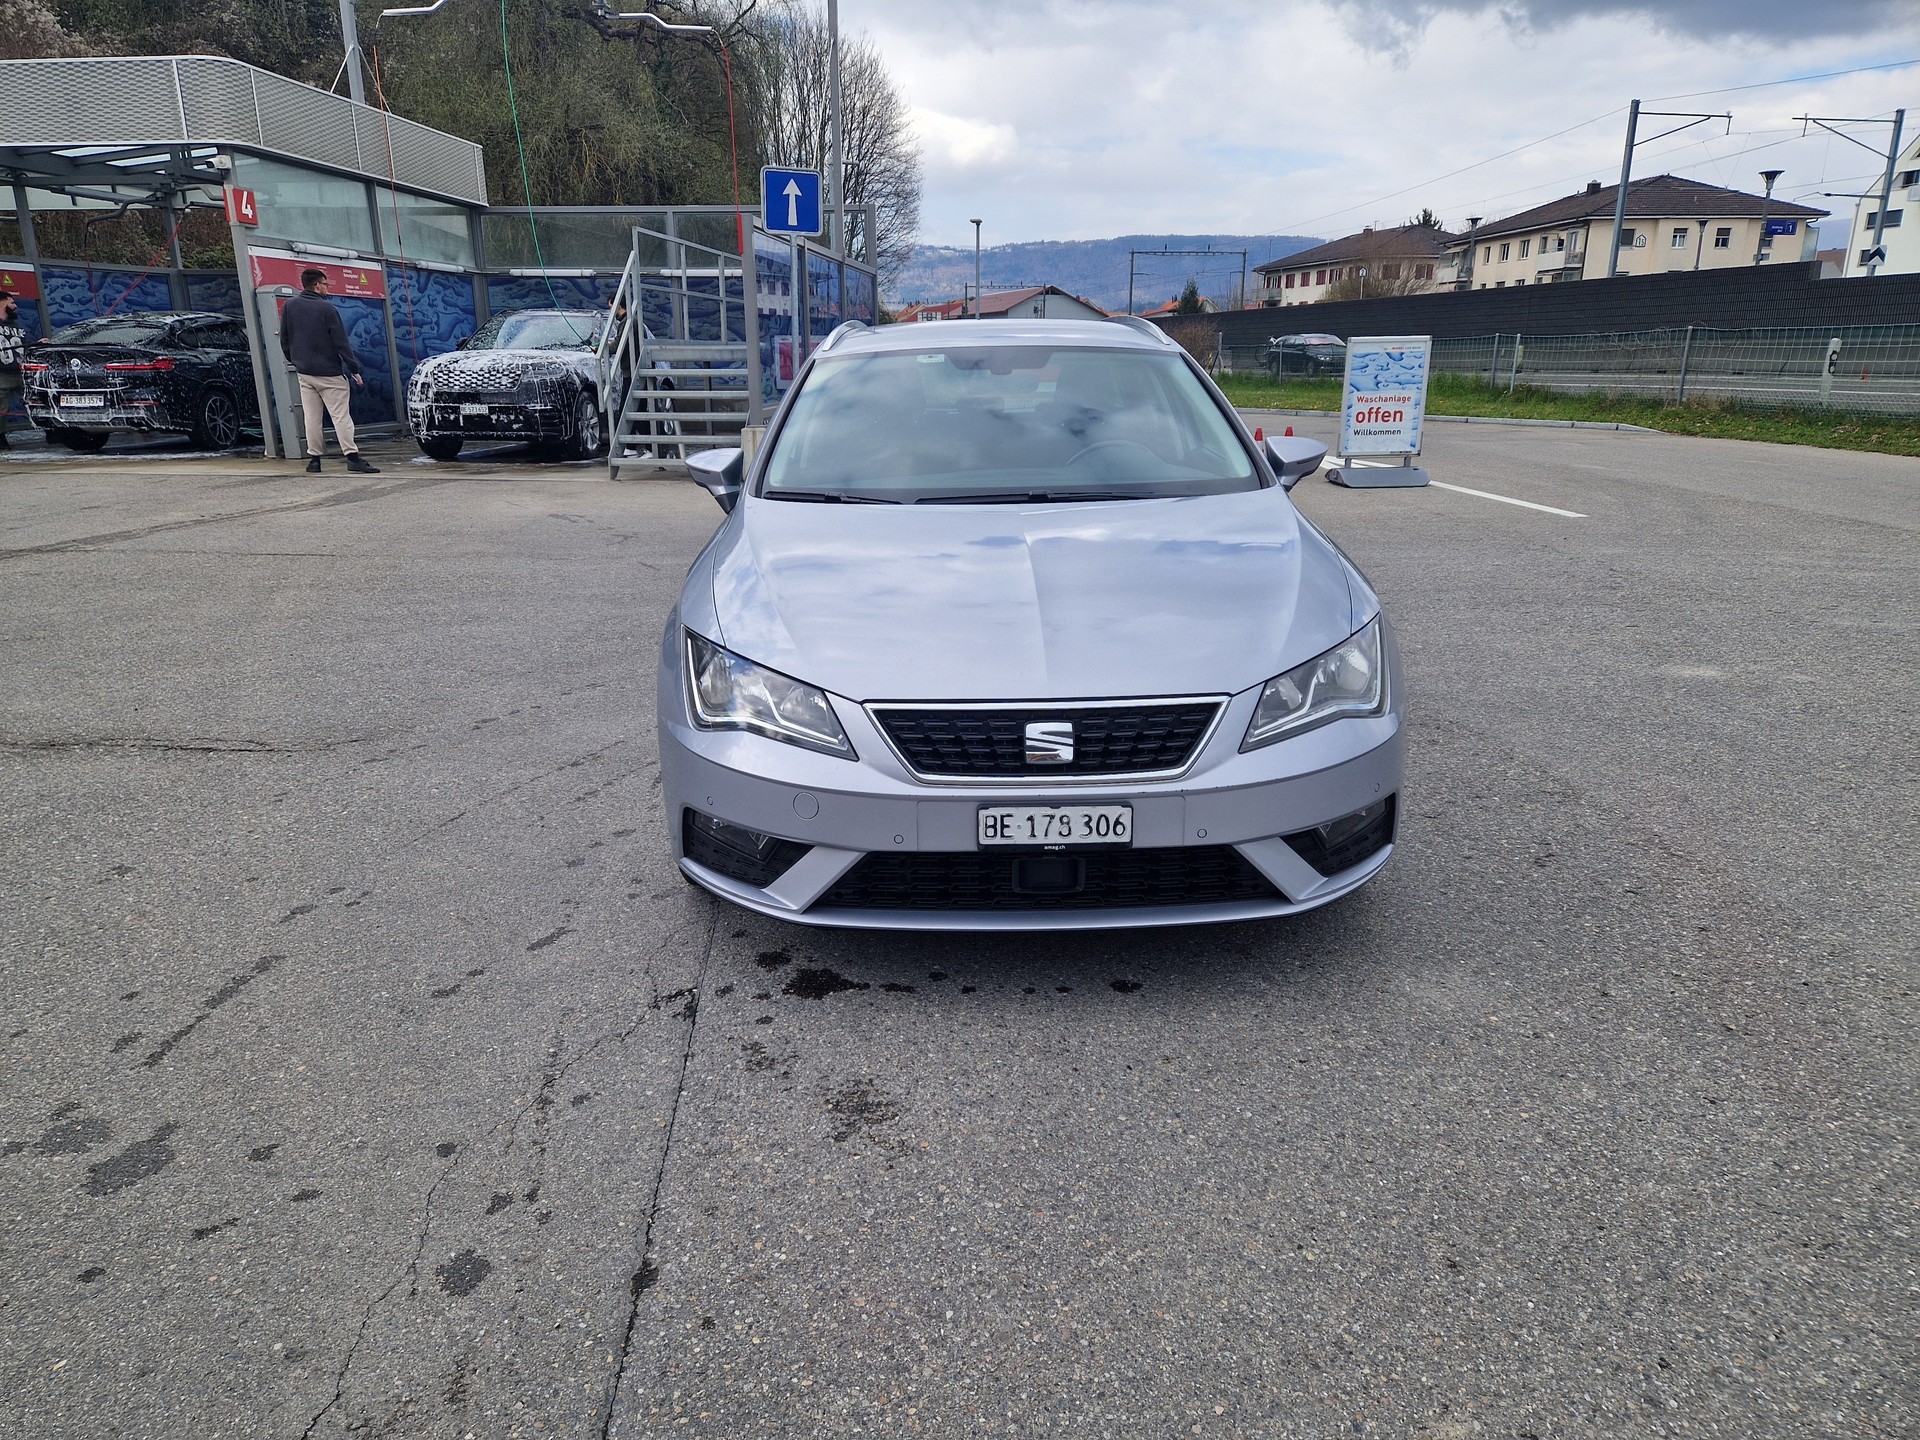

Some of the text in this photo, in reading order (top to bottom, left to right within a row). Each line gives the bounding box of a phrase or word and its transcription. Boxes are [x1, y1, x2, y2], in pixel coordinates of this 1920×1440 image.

[242, 190, 253, 218] 4
[1356, 395, 1411, 404] Waschanlage
[1355, 406, 1404, 423] offen
